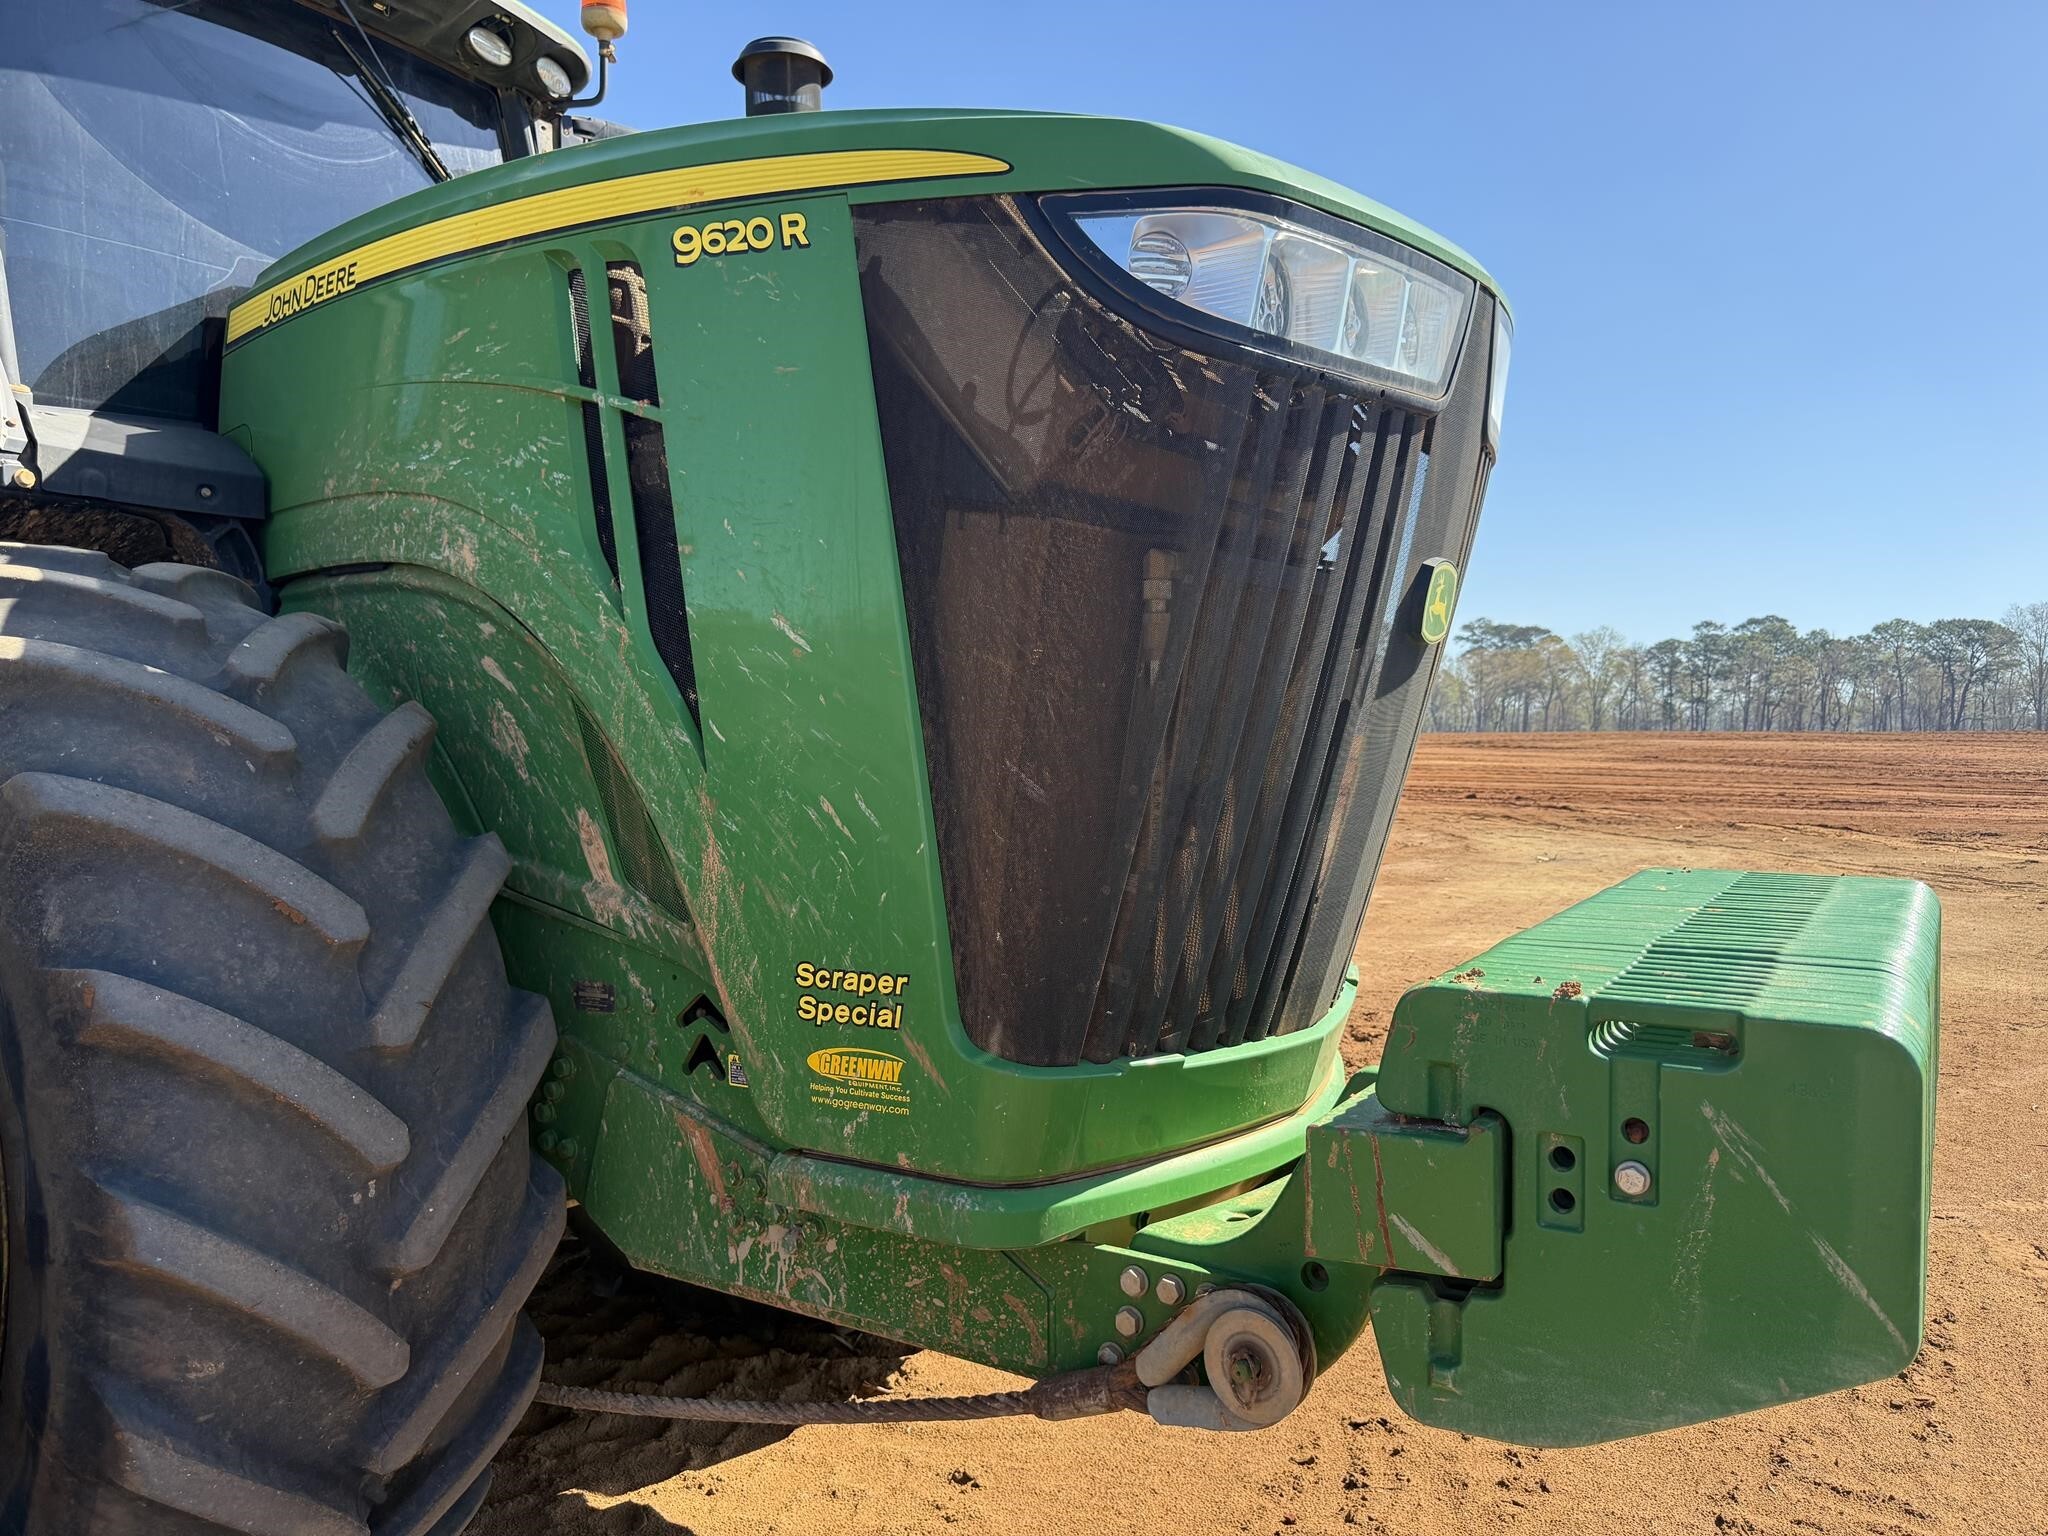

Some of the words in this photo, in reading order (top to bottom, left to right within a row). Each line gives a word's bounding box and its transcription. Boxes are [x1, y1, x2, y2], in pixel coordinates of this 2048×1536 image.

[672, 216, 775, 266] 9620
[780, 212, 810, 250] R
[264, 284, 303, 324] JOHN
[304, 262, 357, 304] DEERE
[795, 961, 910, 998] Scraper
[797, 994, 904, 1029] Special
[820, 1053, 903, 1082] GREENWAY
[810, 1082, 834, 1095] Helping
[835, 1085, 848, 1095] You
[849, 1087, 880, 1099] Cultivate
[880, 1091, 911, 1103] Success
[811, 1095, 910, 1116] www.gogreenway.com
